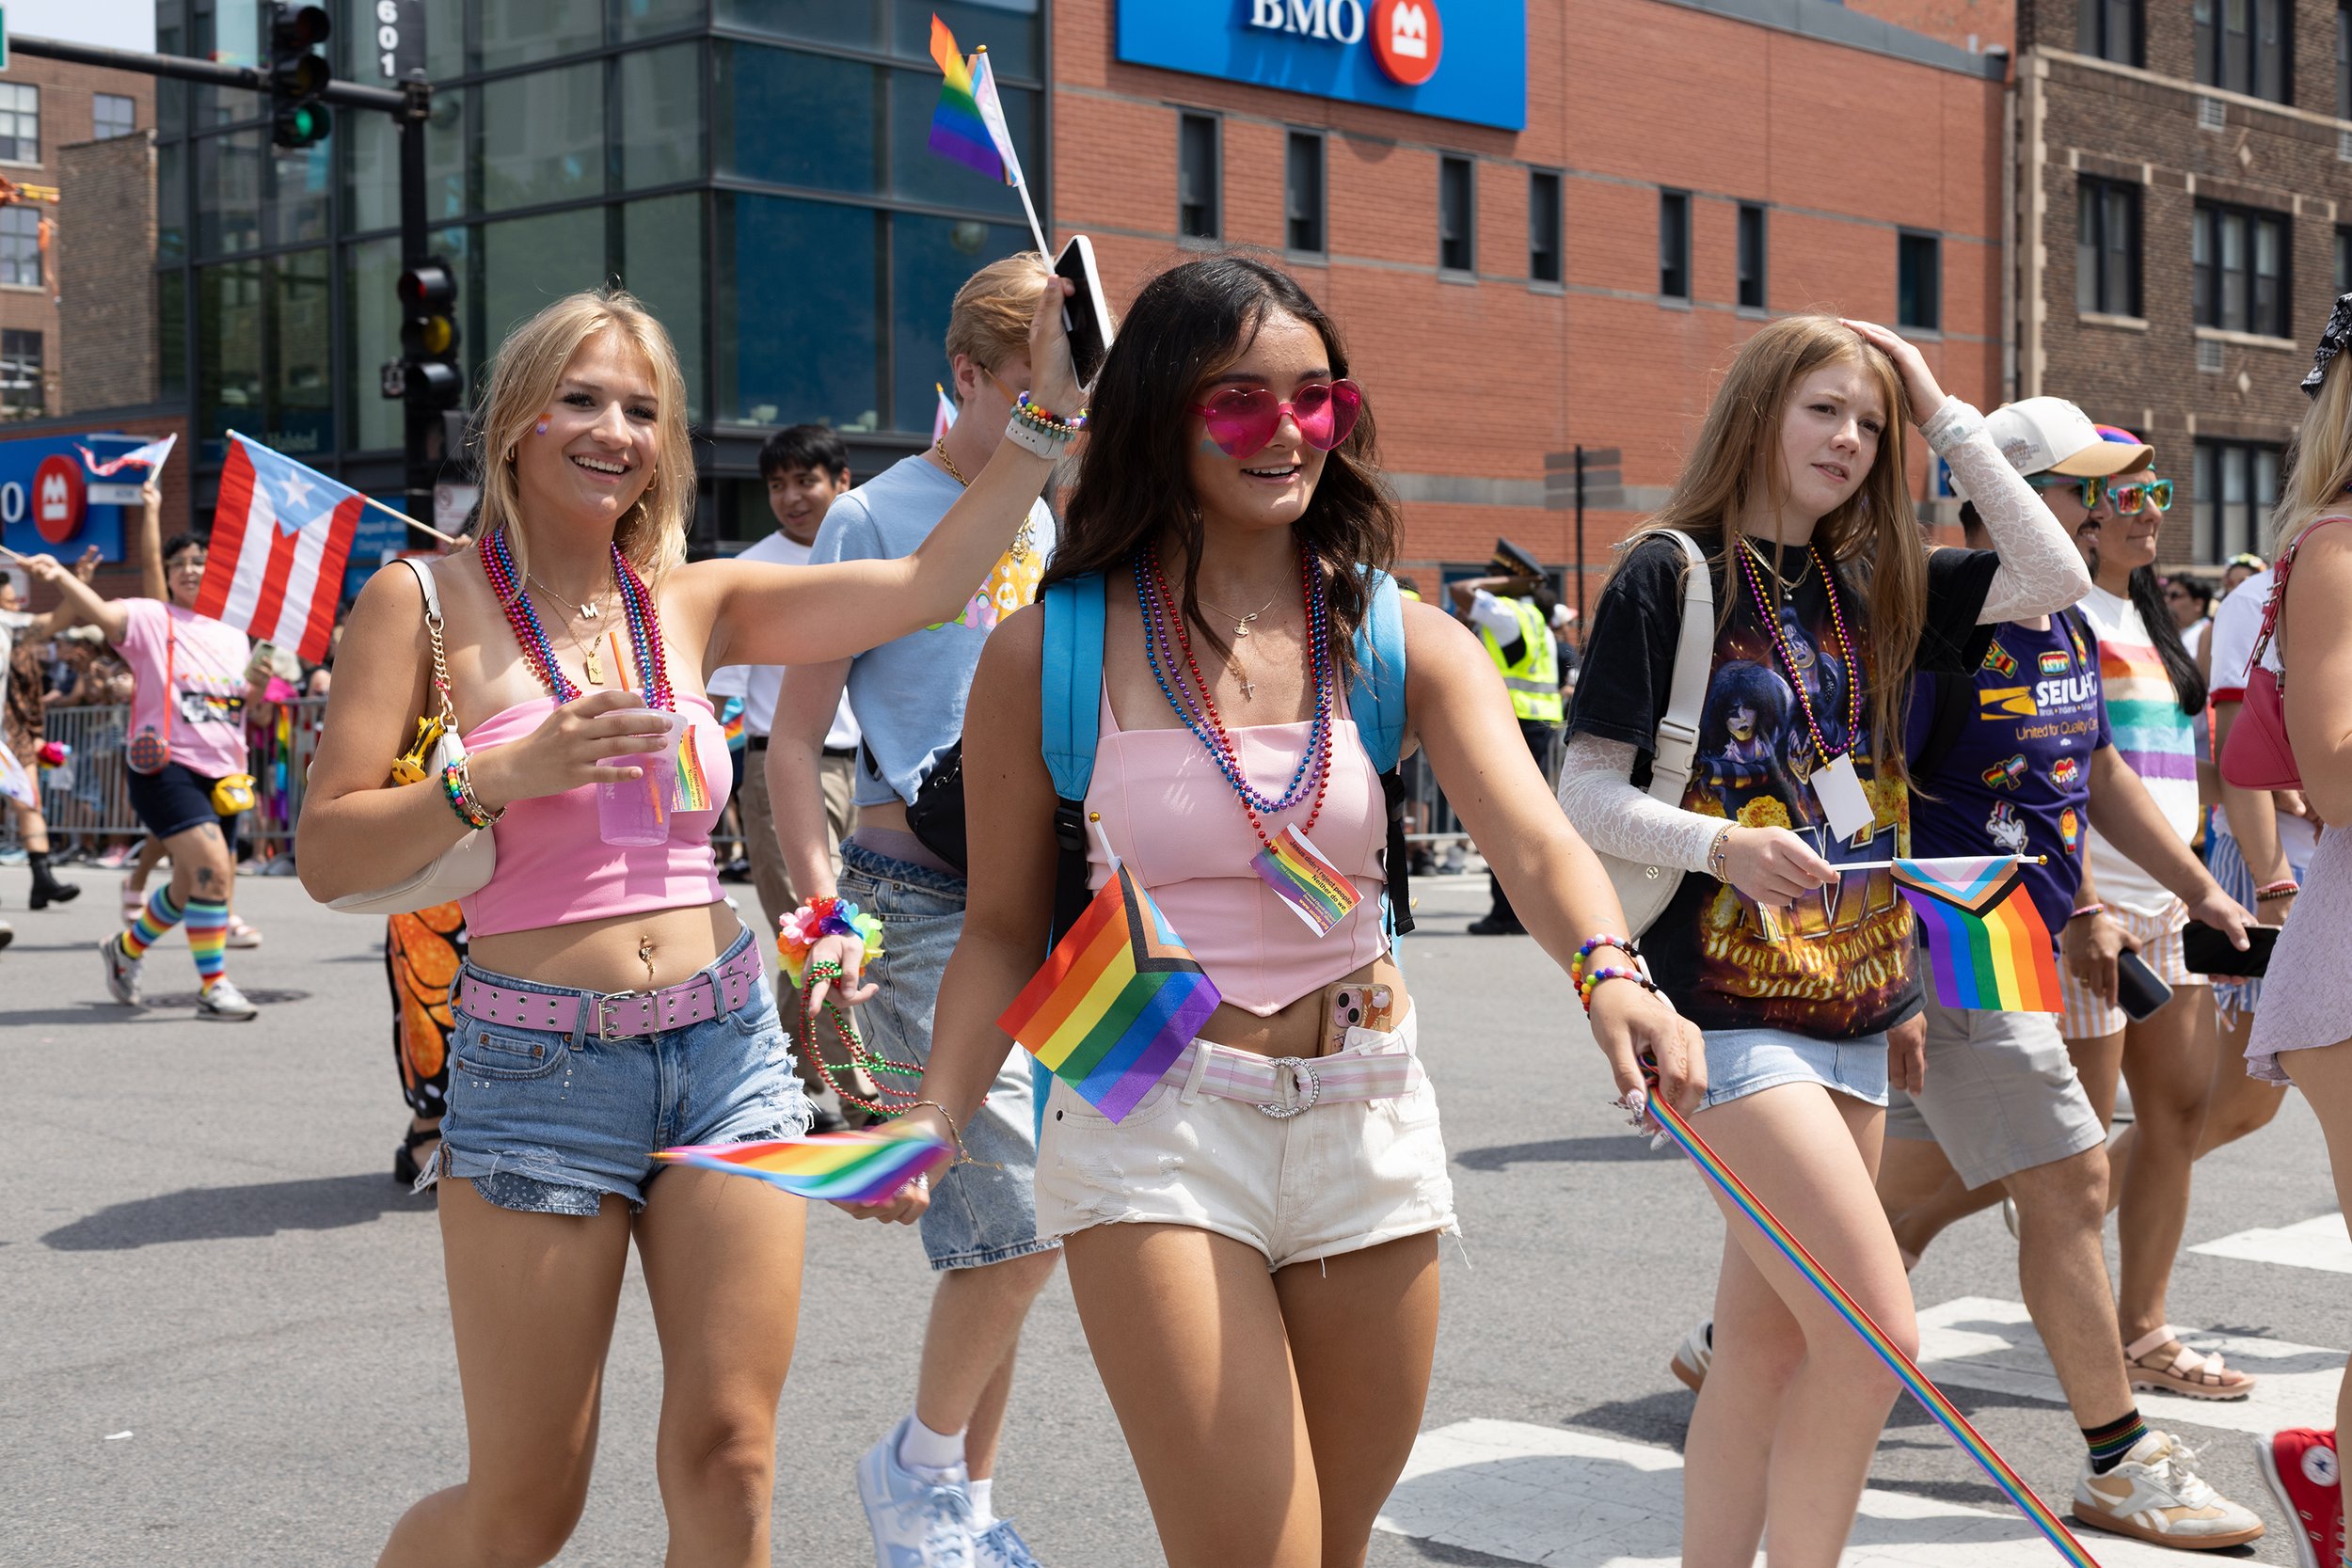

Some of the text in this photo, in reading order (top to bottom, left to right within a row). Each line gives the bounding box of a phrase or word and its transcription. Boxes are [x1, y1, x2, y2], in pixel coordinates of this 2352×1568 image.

[377, 0, 399, 77] 601
[1250, 0, 1365, 44] BMO
[580, 602, 599, 619] M
[2016, 723, 2048, 740] United
[2049, 723, 2059, 736] for
[2060, 720, 2088, 736] Quality
[1290, 840, 1353, 907] Jesus didn't reject people.
[1311, 875, 1347, 911] Neither do we.
[1705, 929, 1801, 974] WORLD
